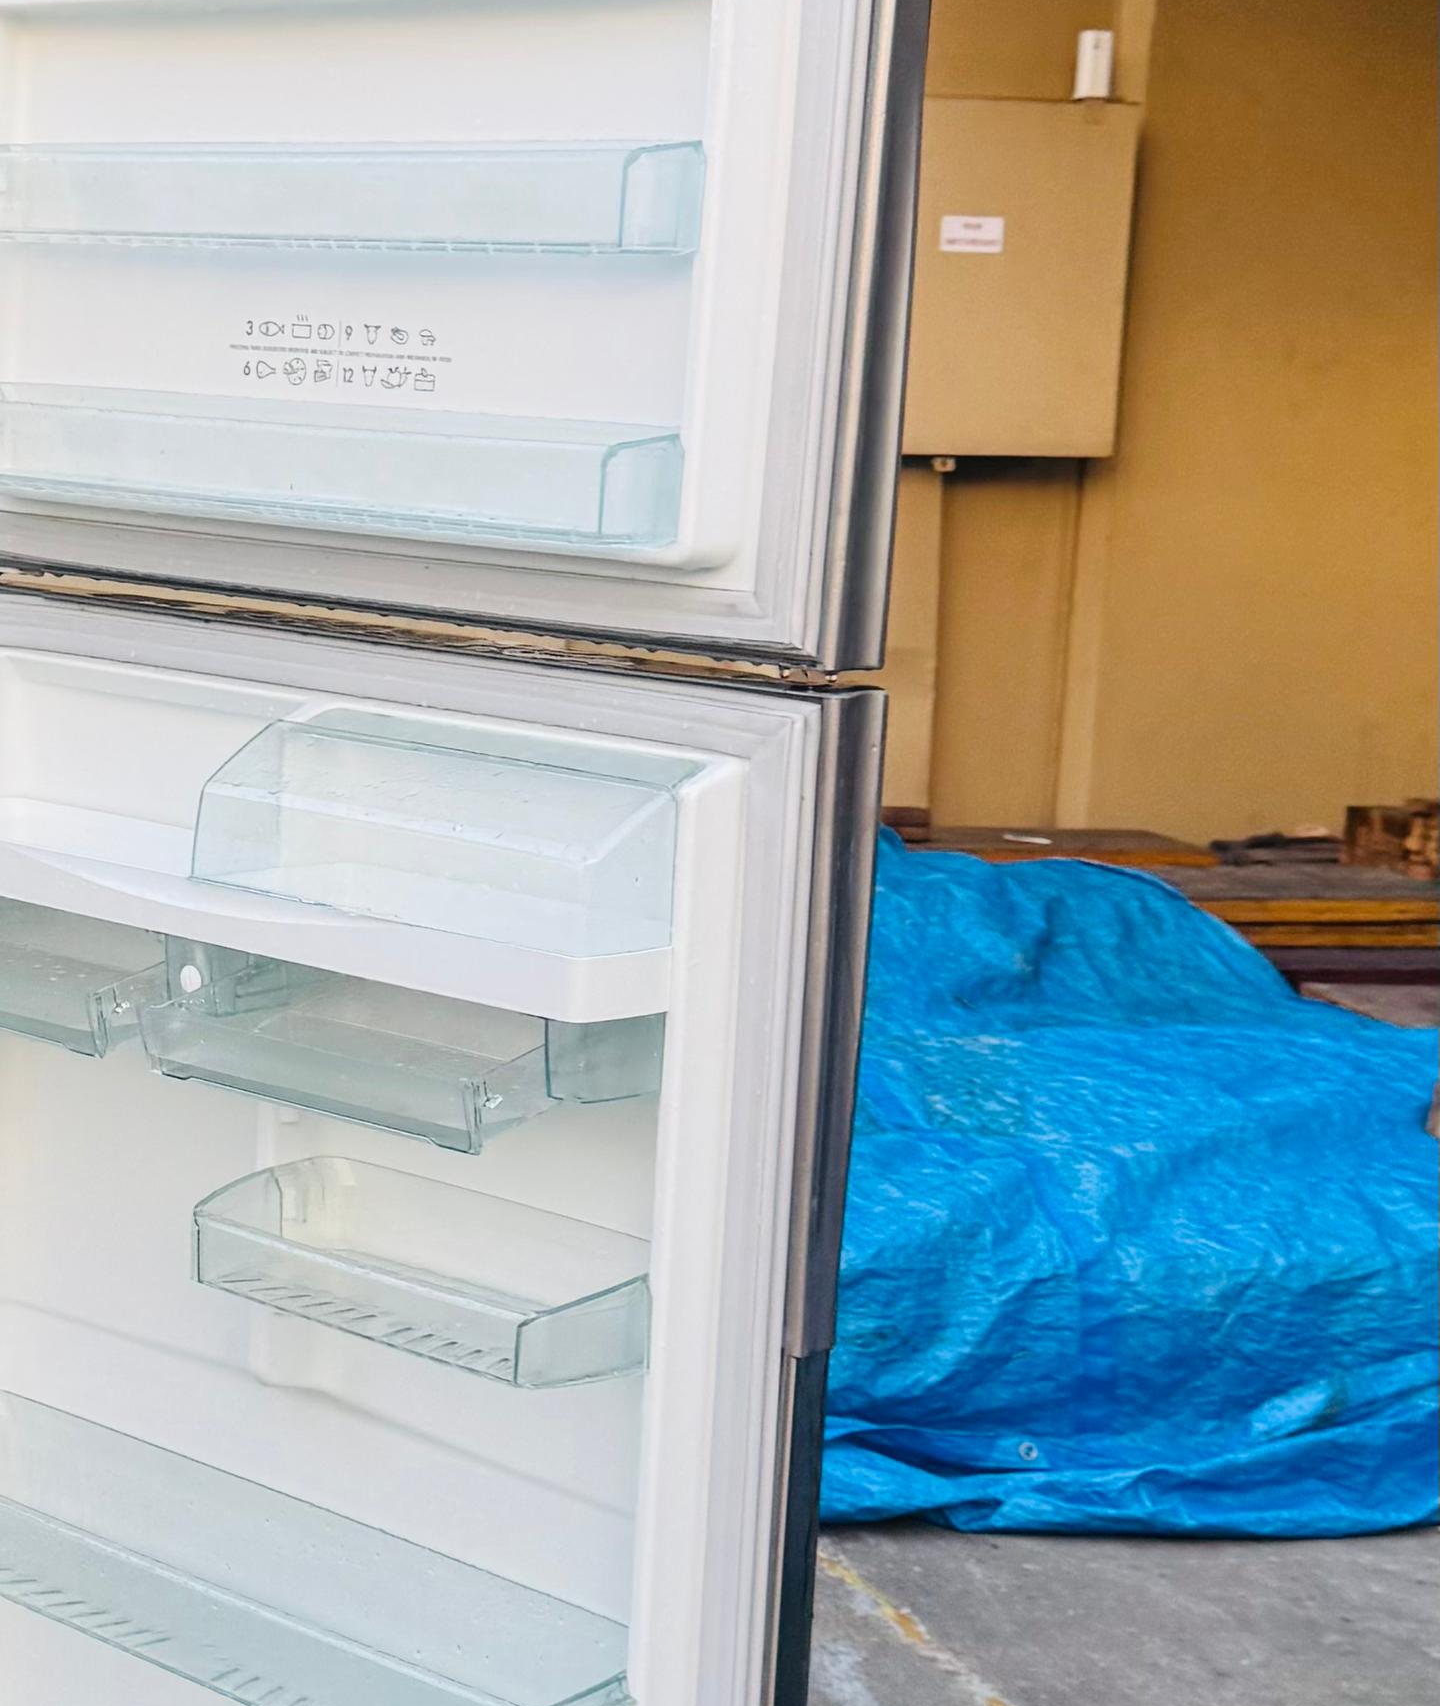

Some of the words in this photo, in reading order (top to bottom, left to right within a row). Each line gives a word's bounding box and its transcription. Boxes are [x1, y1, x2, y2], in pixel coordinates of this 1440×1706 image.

[246, 320, 254, 336] 3
[344, 325, 353, 340] 9
[243, 360, 251, 376] 6
[343, 367, 354, 383] 12
